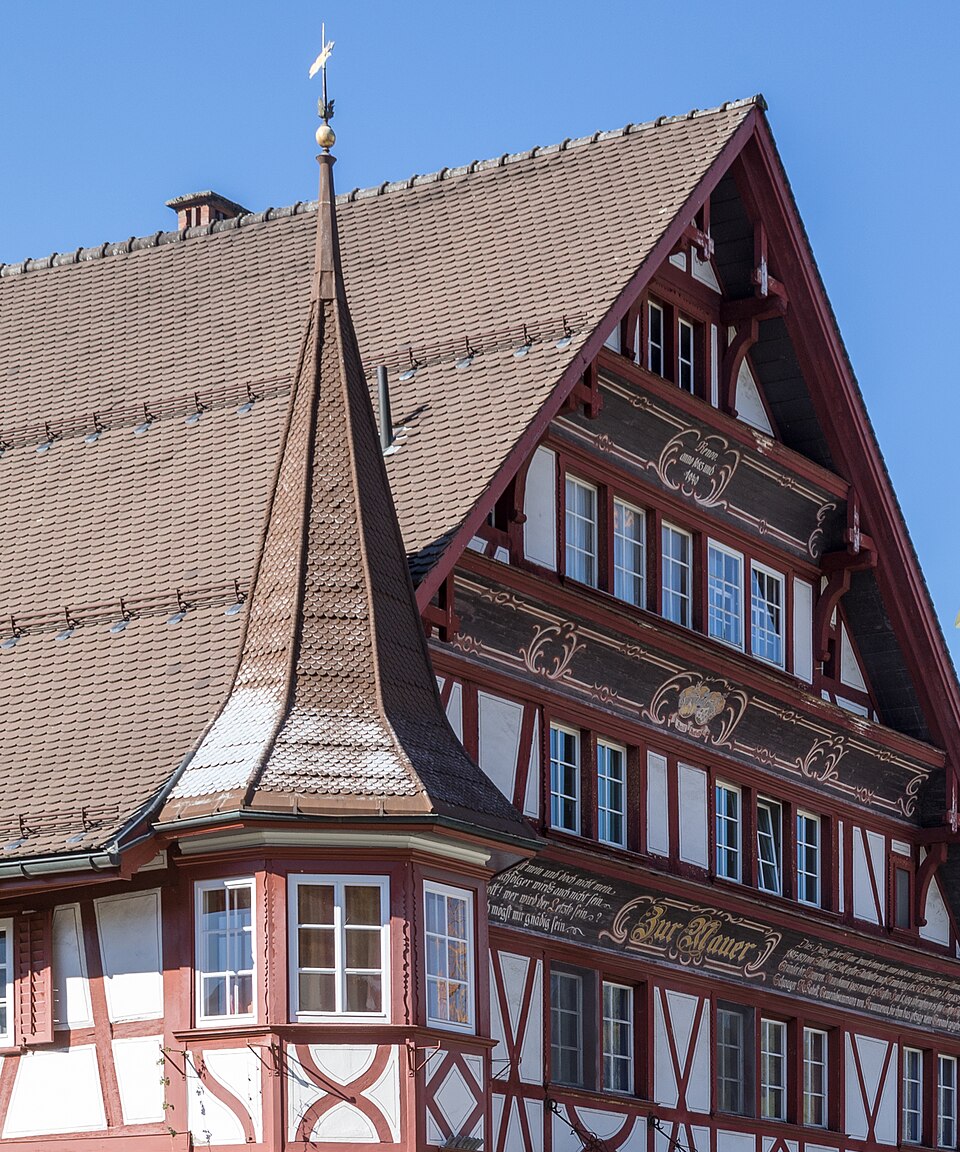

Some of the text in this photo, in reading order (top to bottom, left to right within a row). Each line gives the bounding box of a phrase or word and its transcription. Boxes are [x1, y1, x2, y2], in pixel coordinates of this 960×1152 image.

[543, 869, 561, 880] und
[503, 889, 520, 901] wer
[631, 904, 757, 961] Zur Mauer
